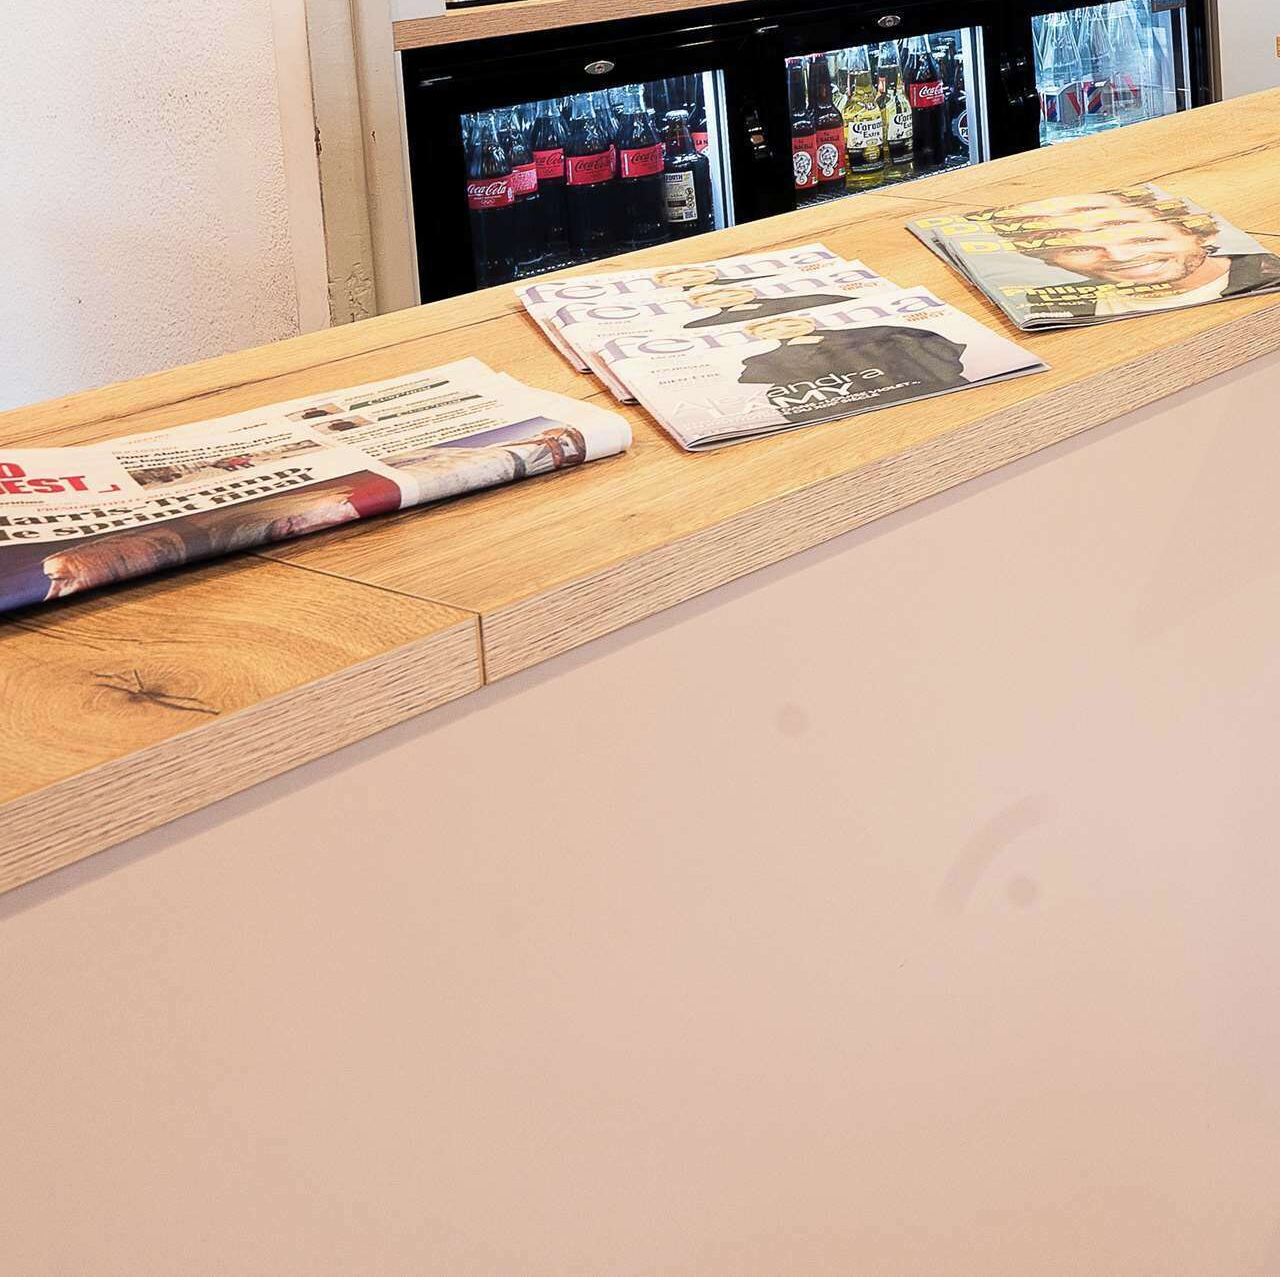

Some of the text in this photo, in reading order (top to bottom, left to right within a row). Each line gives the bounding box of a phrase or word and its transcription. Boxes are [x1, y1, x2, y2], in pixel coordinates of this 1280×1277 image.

[1002, 281, 1137, 297] Philippe
[0, 476, 88, 496] EST
[0, 466, 313, 526] arris-Trump,
[53, 501, 203, 536] sprint
[210, 473, 316, 506] final
